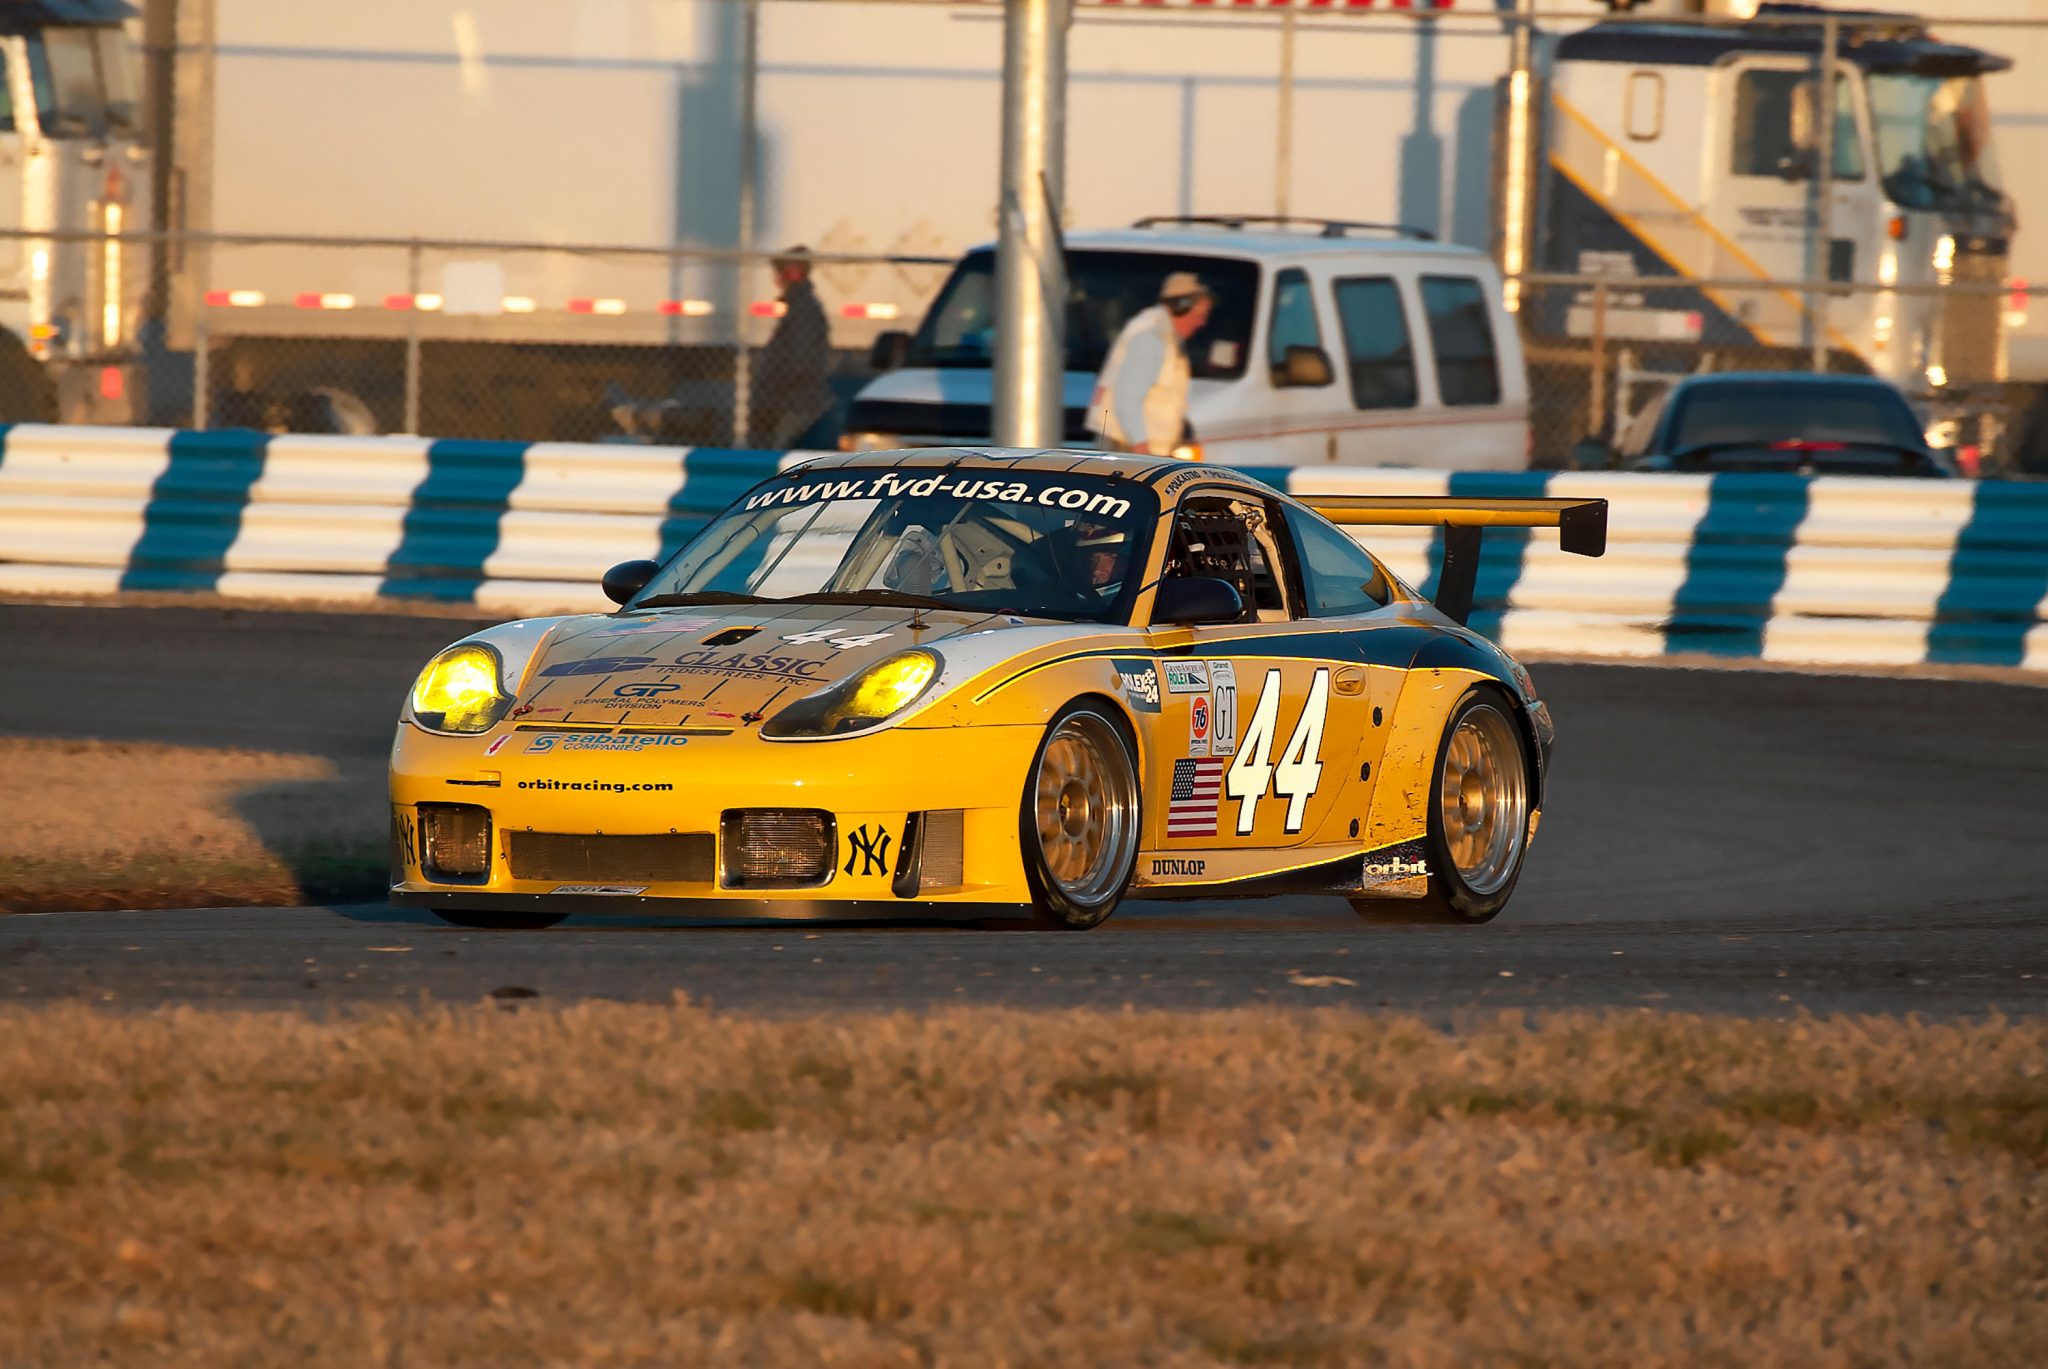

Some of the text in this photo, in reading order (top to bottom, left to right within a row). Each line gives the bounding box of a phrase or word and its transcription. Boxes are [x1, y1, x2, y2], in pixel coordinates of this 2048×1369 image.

[744, 472, 1131, 519] www.fvd-usa.com
[778, 628, 895, 650] 44
[674, 651, 827, 676] CLASSIC
[656, 666, 810, 687] INDUSTRIES INC.
[1120, 672, 1146, 693] ROLEX
[1168, 673, 1188, 685] ROLEX
[574, 697, 707, 708] GENERAL POLYMERS
[1145, 684, 1159, 704] 24
[604, 703, 663, 711] DIVISION
[1214, 685, 1236, 741] GT
[1193, 706, 1208, 729] 76
[563, 743, 644, 752] COMPANIES
[564, 734, 689, 747] sabatello
[1215, 745, 1234, 754] Touring
[1226, 667, 1330, 837] 44
[518, 779, 673, 793] orbitracing.com
[1152, 859, 1206, 875] DUNLOP
[1366, 855, 1427, 875] orbit
